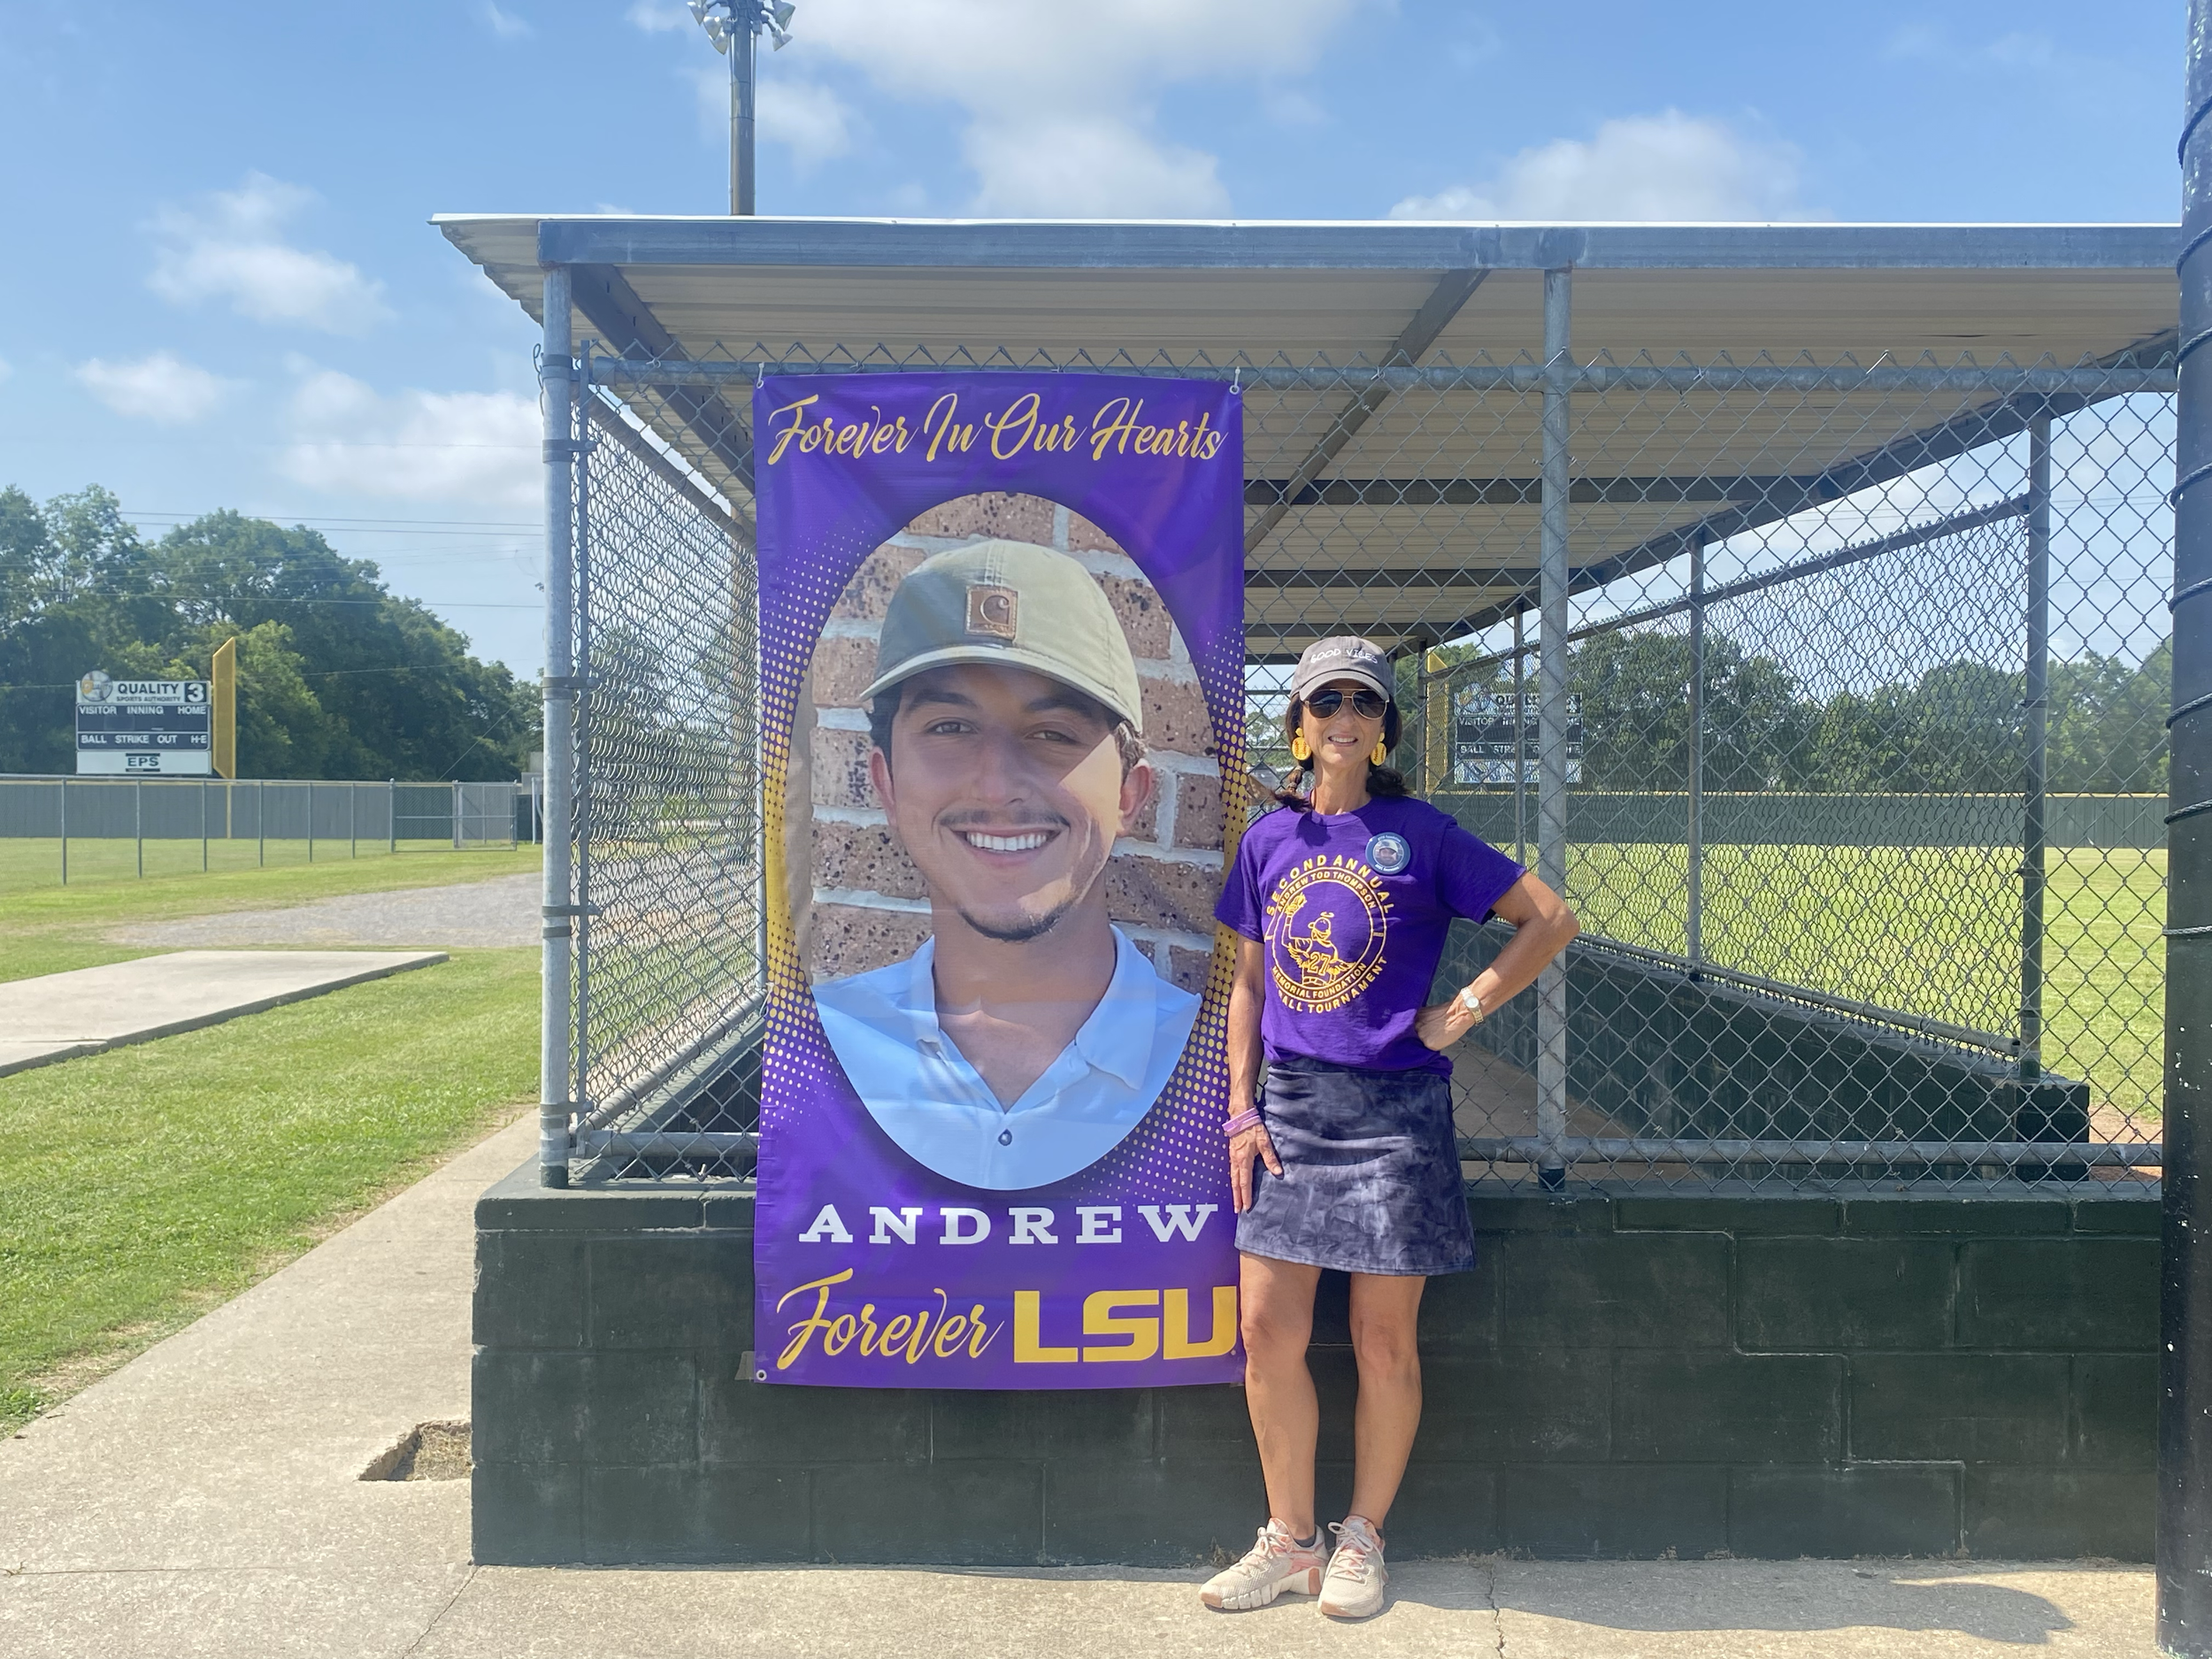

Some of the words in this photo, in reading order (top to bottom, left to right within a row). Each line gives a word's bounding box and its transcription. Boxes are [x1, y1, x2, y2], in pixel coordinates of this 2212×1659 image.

[767, 394, 919, 465] Forever
[924, 394, 984, 462] In
[984, 393, 1087, 460] Our
[1089, 396, 1228, 461] Hearts
[1310, 648, 1341, 664] GOOD
[79, 706, 117, 715] VISITOR
[127, 706, 164, 715] INNING
[178, 706, 206, 715] HOME
[118, 683, 179, 695] QUALITY
[187, 683, 204, 703] 3
[81, 735, 107, 744] BALL
[115, 735, 150, 744] STRIKE
[157, 735, 177, 744] OUT
[127, 757, 159, 767] EPS
[1266, 854, 1326, 917] SECOND
[1333, 854, 1395, 914] ANNUAL
[1276, 874, 1310, 913] ANDREW
[1310, 872, 1331, 882] TOD
[1332, 872, 1377, 910] THOMPSON
[1271, 964, 1310, 999] MEMORIAL
[1312, 963, 1367, 999] FOUNDATION
[1308, 952, 1331, 976] 27
[1308, 956, 1387, 1014] TOURNAMENT
[798, 1203, 1218, 1245] ANDREW
[776, 1267, 1004, 1371] Forever
[1014, 1286, 1237, 1363] LSU
